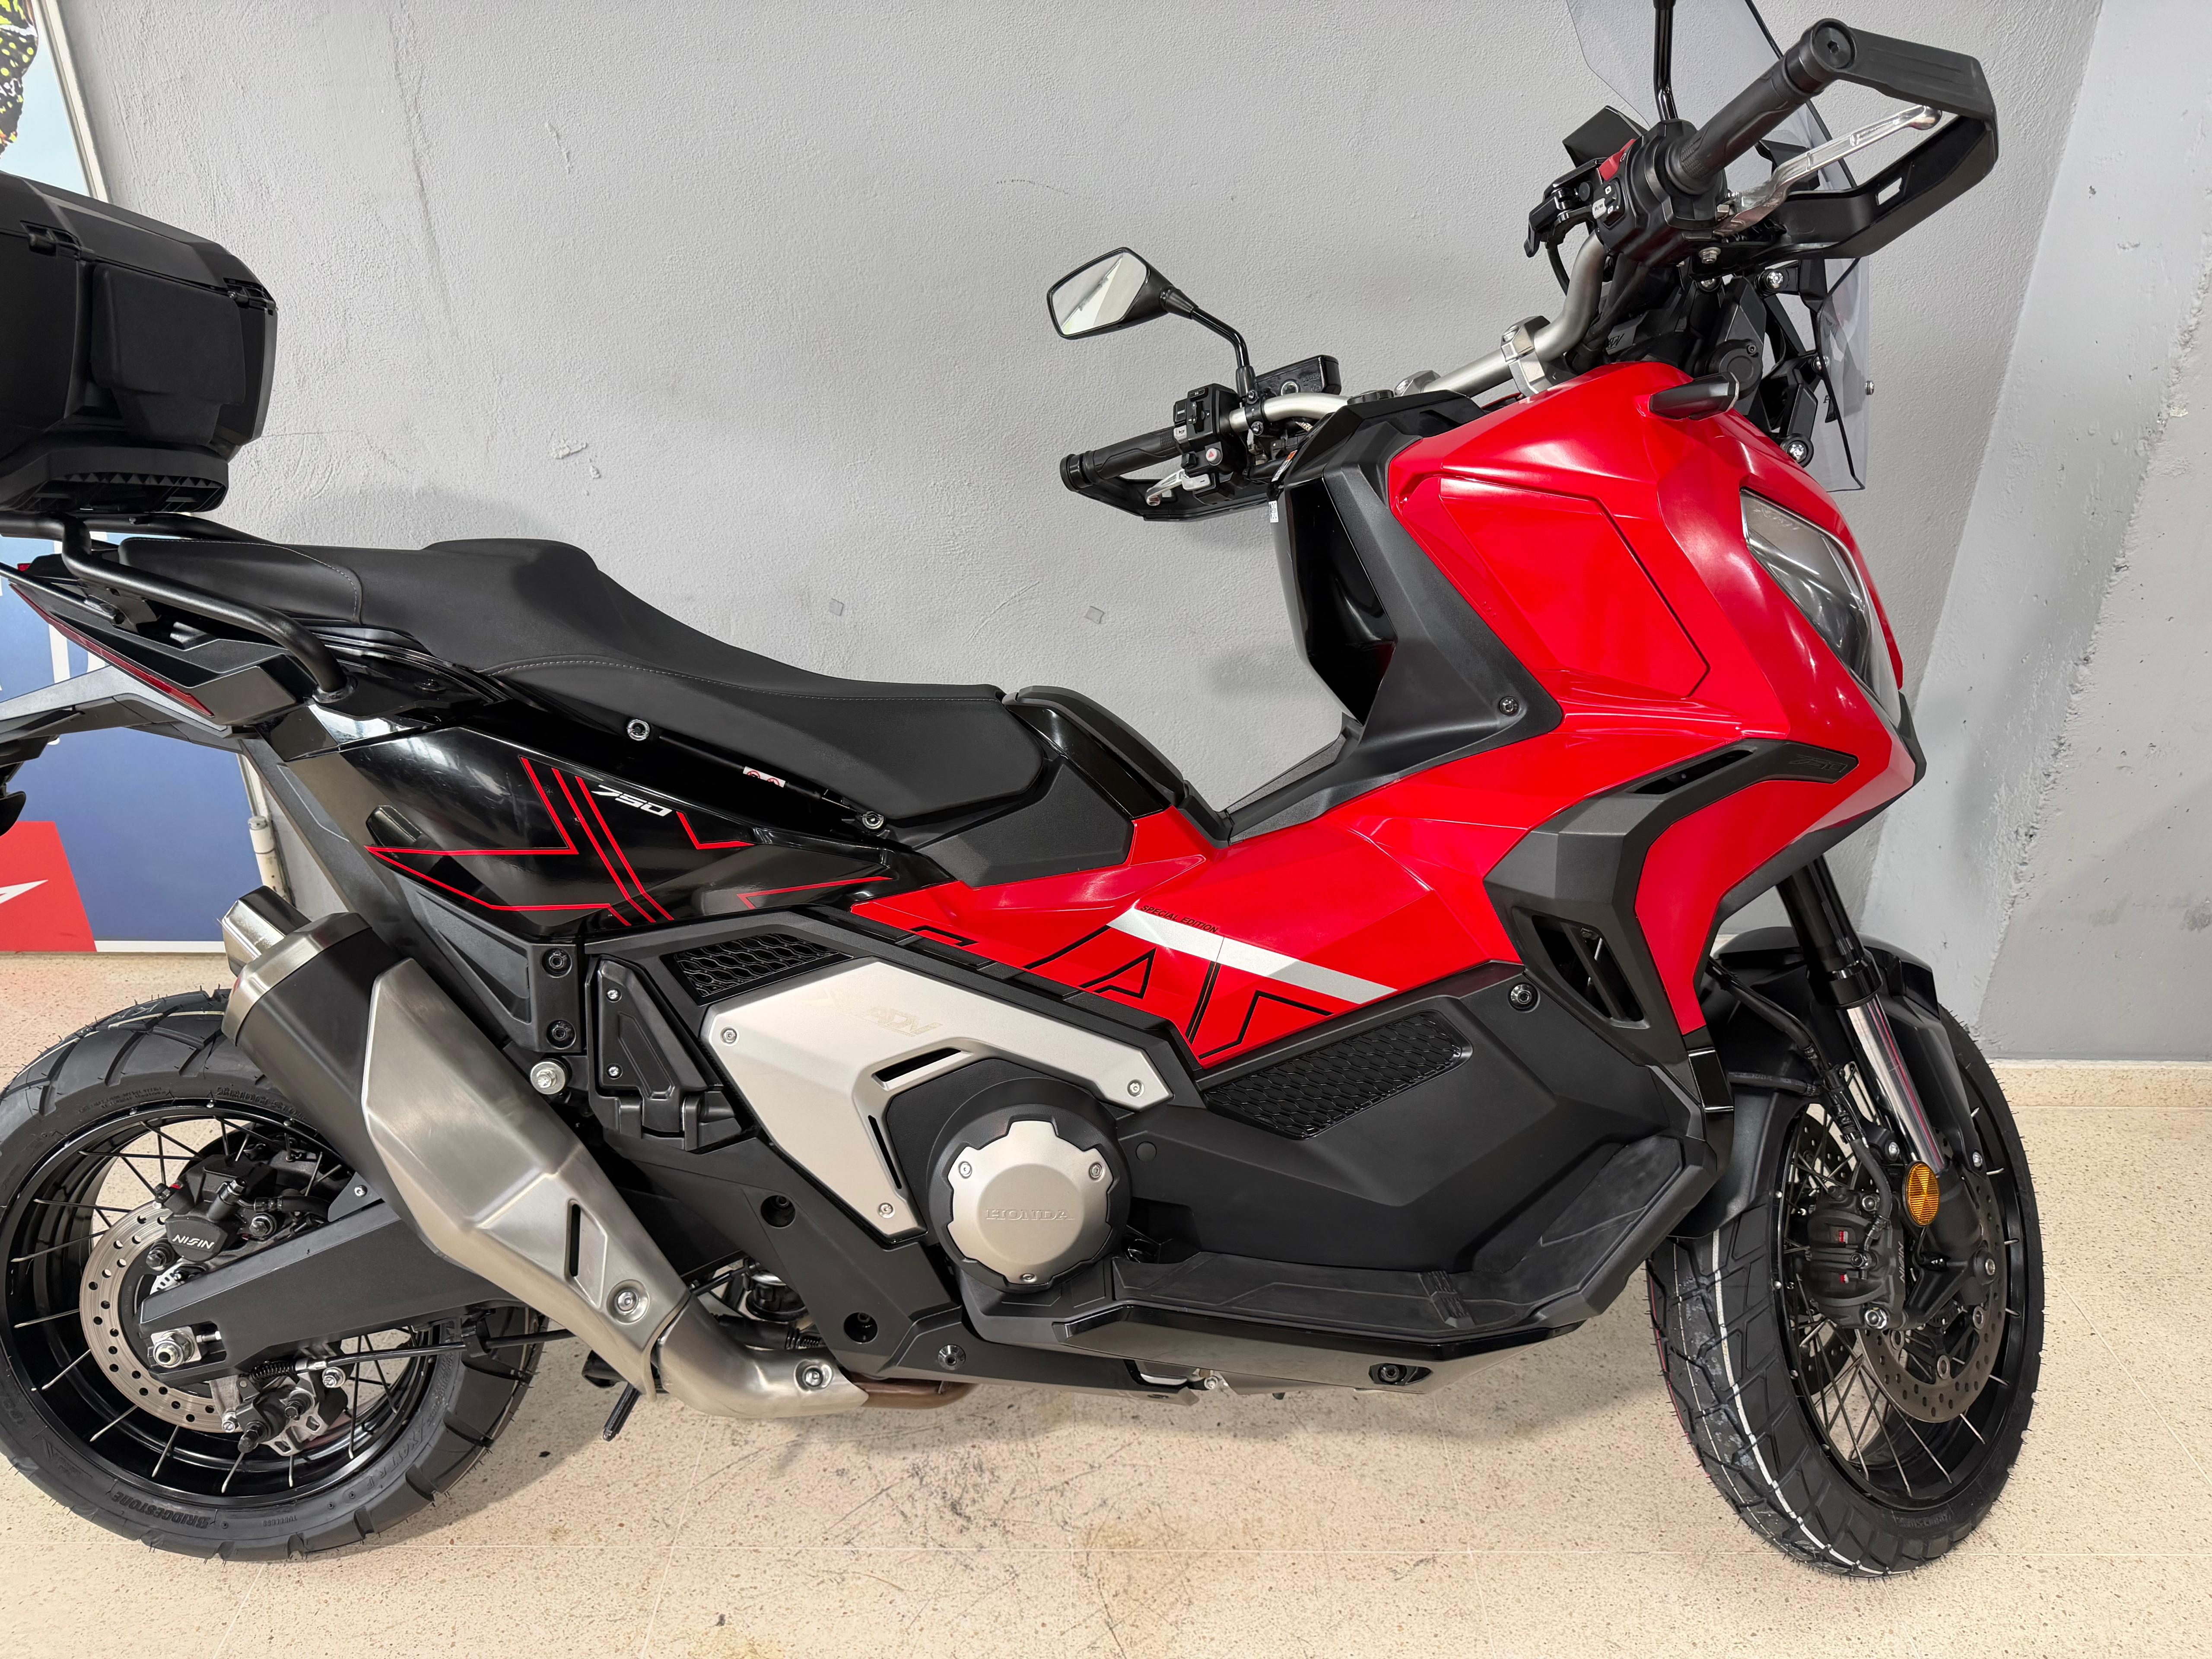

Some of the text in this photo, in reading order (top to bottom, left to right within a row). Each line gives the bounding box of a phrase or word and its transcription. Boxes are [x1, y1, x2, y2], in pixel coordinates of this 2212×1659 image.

[591, 785, 673, 817] 750
[1140, 905, 1219, 933] SPECIAL EDITION
[986, 1209, 1075, 1220] HONDA
[172, 1234, 215, 1249] NISSIN
[111, 1491, 211, 1529] BRIDGESTONE
